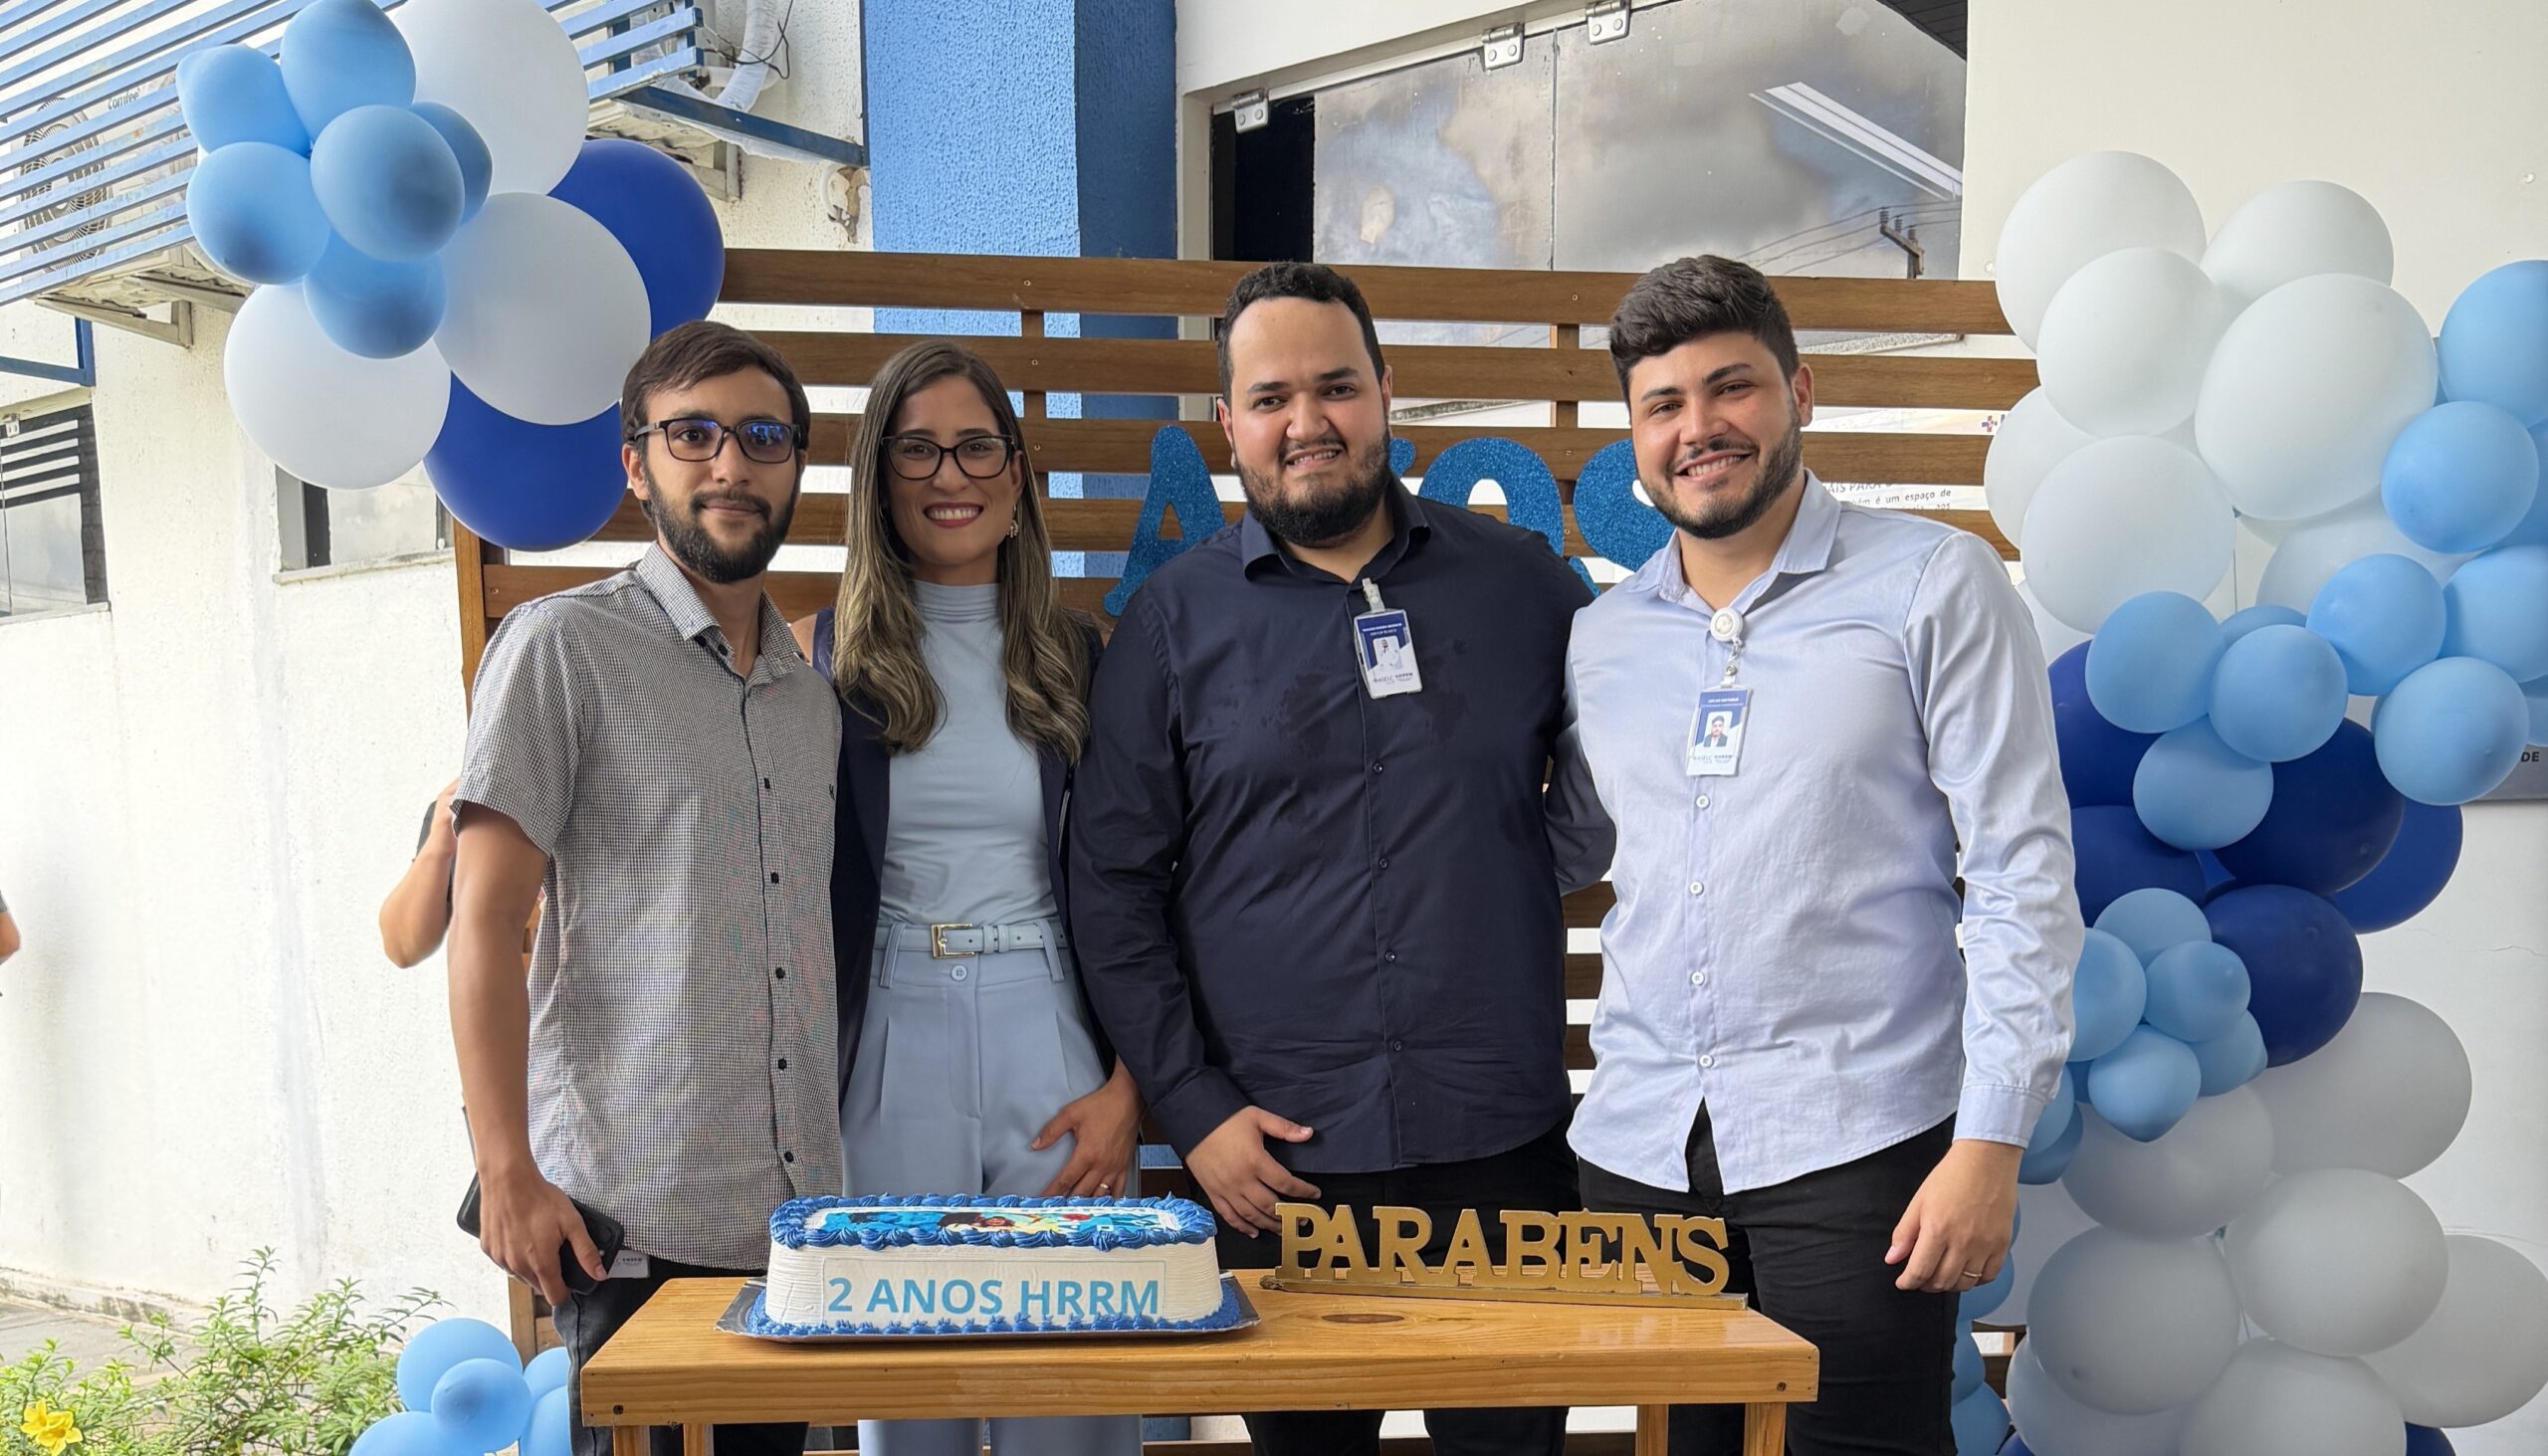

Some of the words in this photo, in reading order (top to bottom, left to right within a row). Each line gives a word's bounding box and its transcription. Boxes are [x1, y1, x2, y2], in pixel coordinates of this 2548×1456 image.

[1904, 492, 1935, 502] espaço
[1940, 489, 1951, 498] de
[827, 1276, 853, 1313] 2
[866, 1278, 1004, 1317] ANOS
[1020, 1279, 1160, 1318] HRRM
